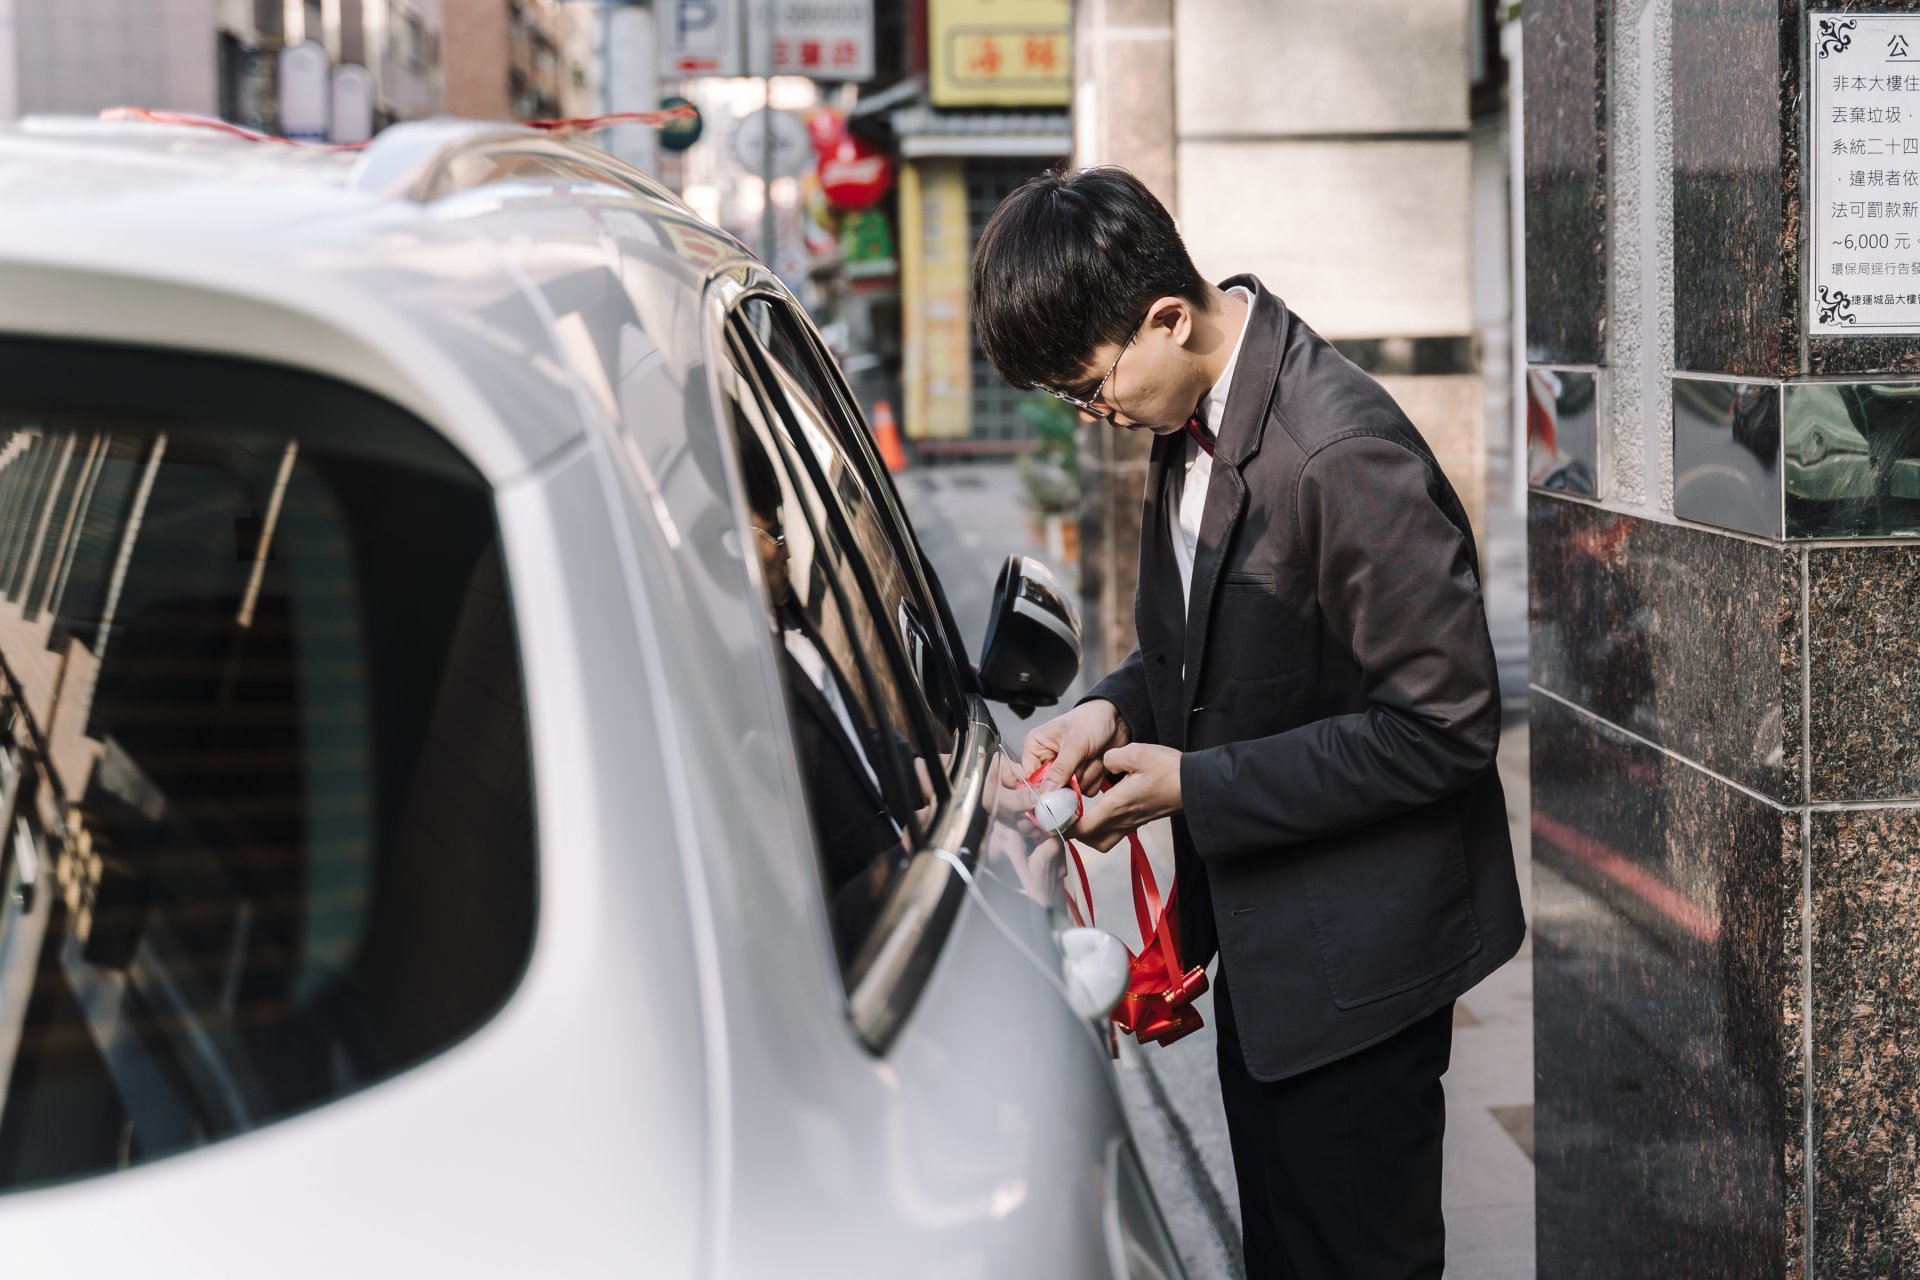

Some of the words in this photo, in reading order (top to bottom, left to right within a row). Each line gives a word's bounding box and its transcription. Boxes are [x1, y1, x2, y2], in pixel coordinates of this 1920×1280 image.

[674, 0, 719, 49] P
[1887, 34, 1909, 57] 公
[1832, 74, 1920, 92] 非本大樓住
[1831, 138, 1919, 155] 系統二十四
[1831, 201, 1919, 219] 法可罰款新
[1832, 233, 1889, 251] ~6,000
[1851, 294, 1920, 305] 捷運城品大樓
